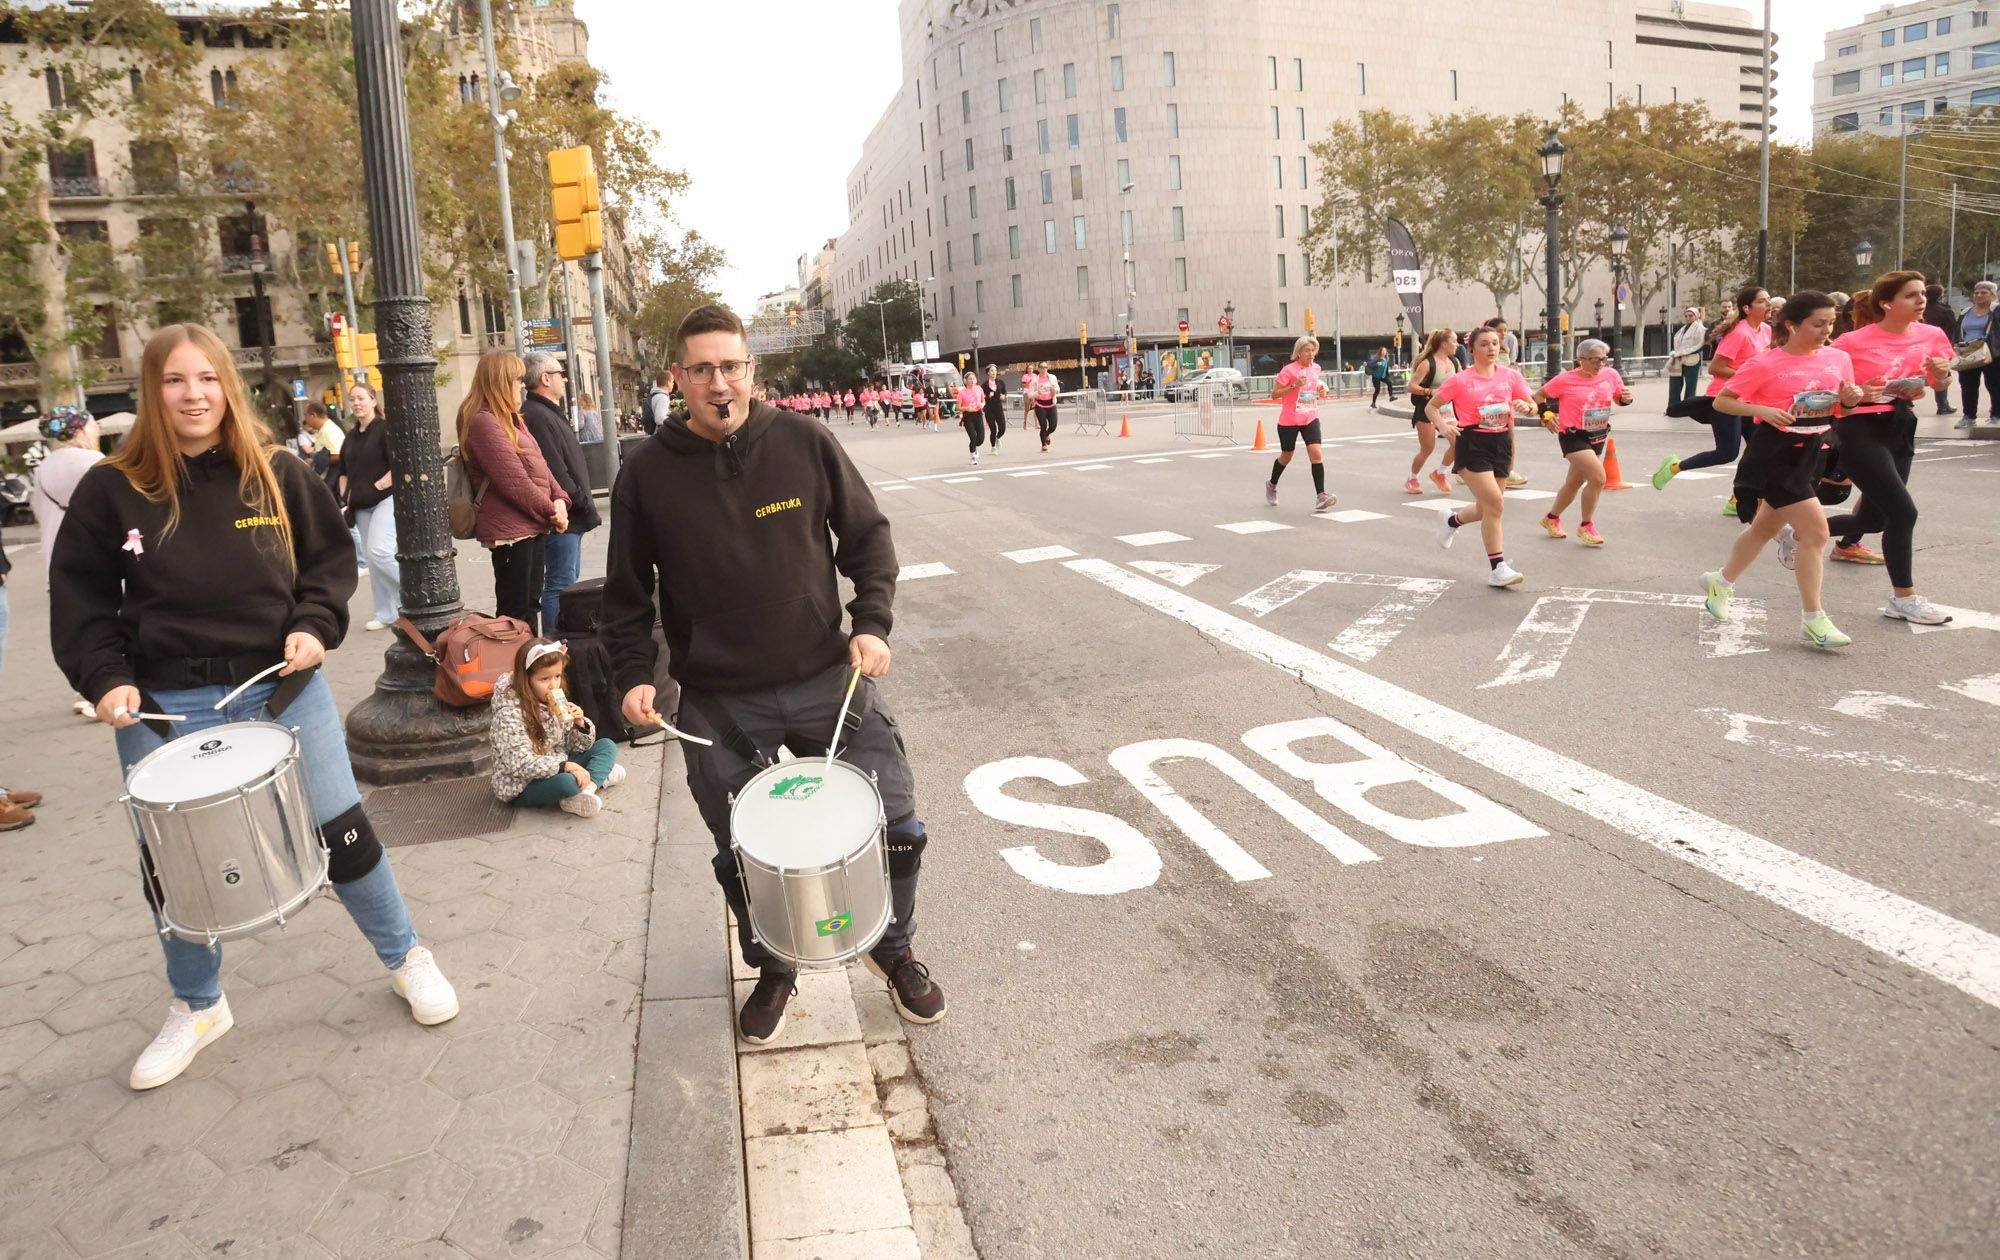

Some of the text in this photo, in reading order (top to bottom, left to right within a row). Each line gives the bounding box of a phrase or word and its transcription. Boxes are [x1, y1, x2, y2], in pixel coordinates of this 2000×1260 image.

[755, 497, 802, 518] CERBATUKA
[234, 516, 282, 529] CERBATUK
[963, 716, 1551, 896] BUS
[883, 844, 913, 852] LLSIX
